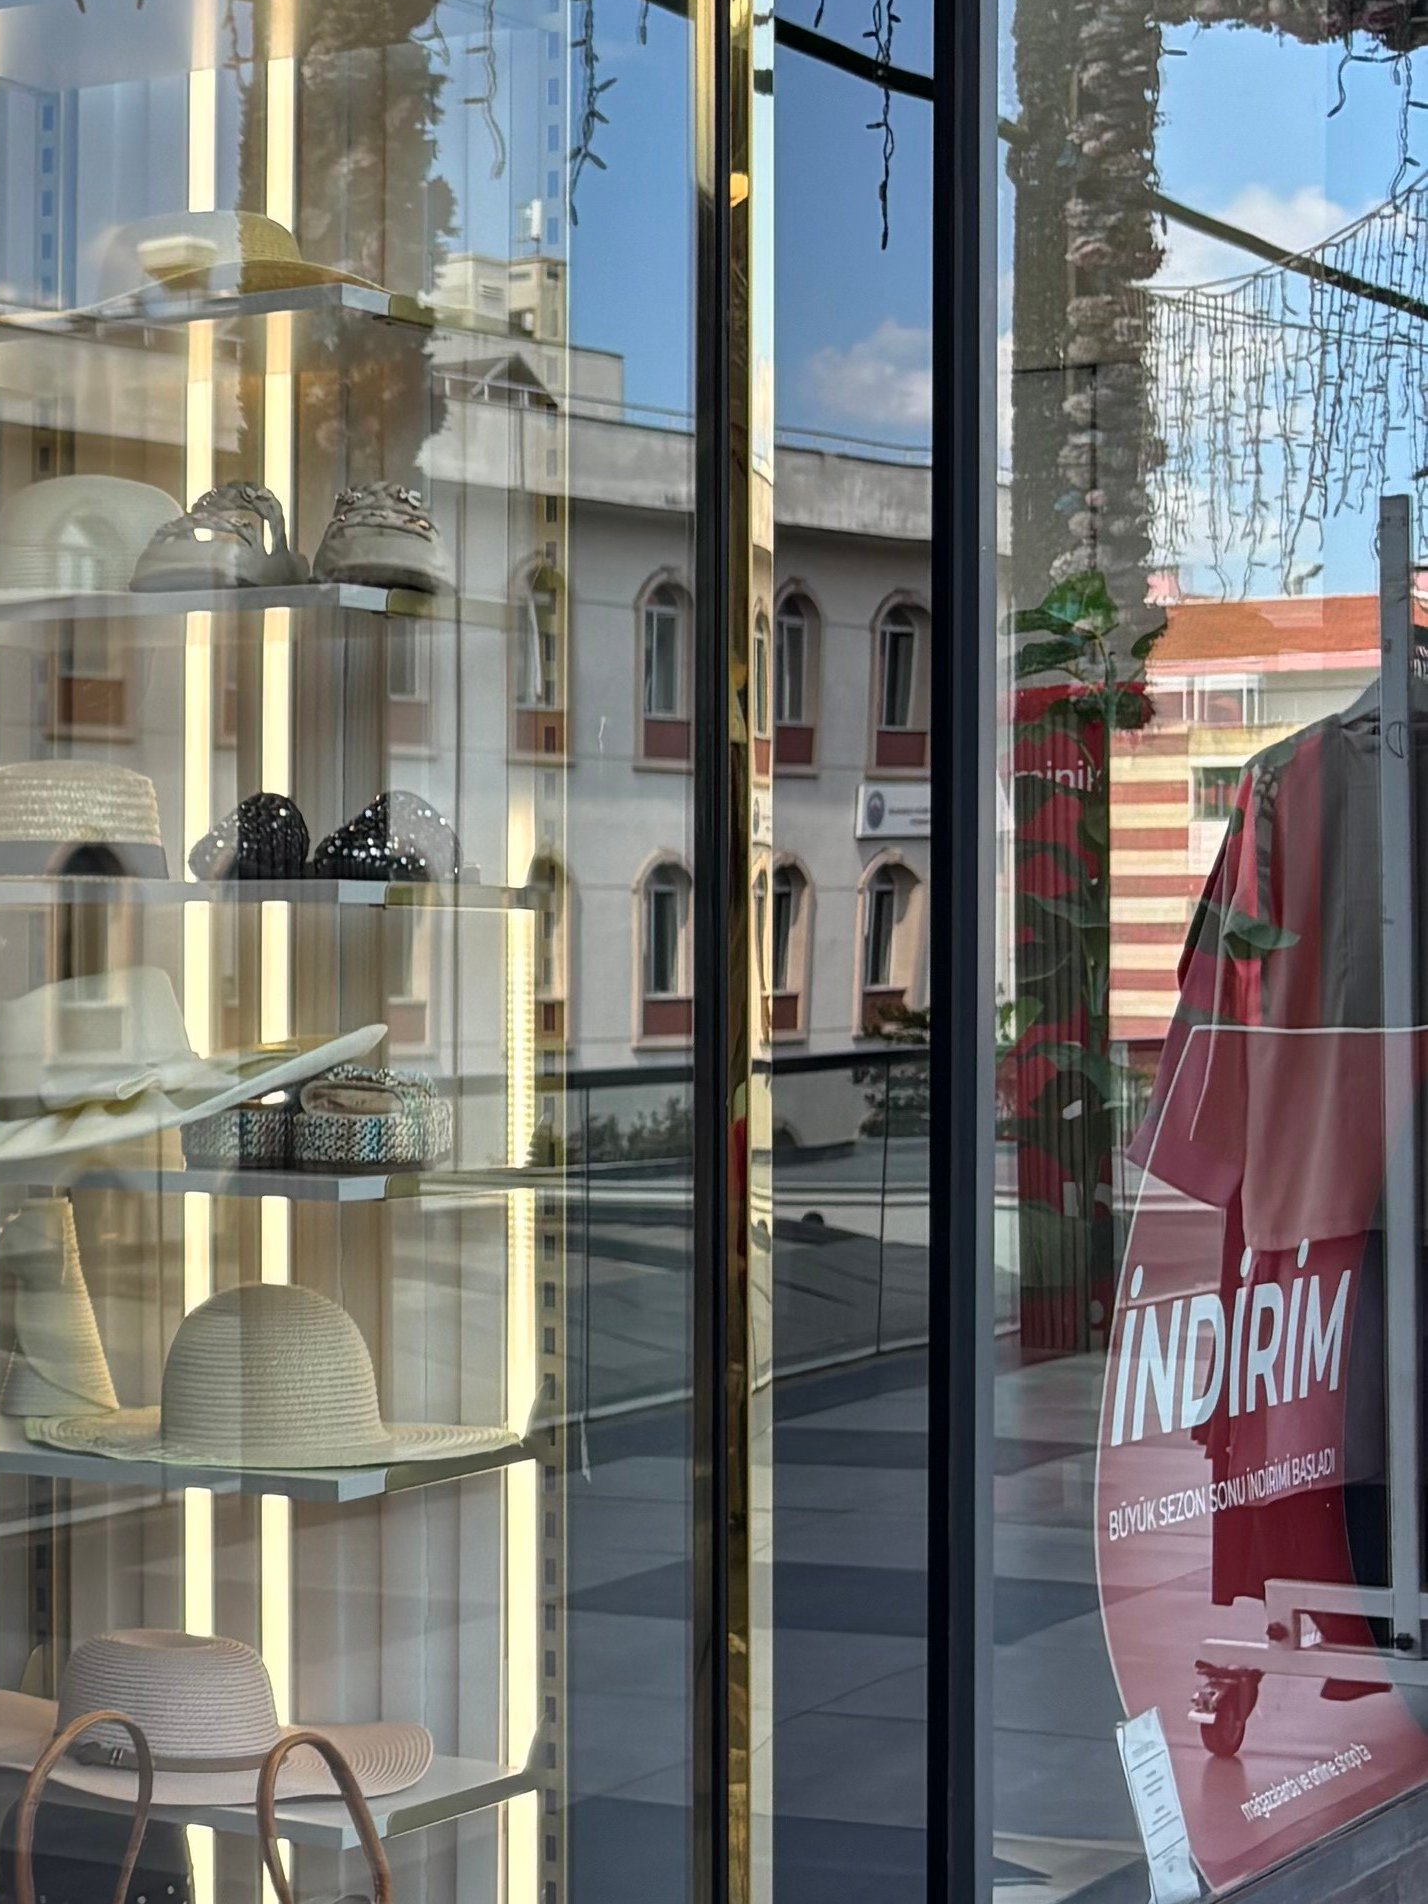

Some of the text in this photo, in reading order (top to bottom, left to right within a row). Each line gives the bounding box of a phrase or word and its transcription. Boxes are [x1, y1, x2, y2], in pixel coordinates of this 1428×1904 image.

[1110, 1238, 1351, 1447] İNDİRİM
[1108, 1447, 1336, 1542] BÜYÜK SEZON SONU İNDİRİMİ BAŞLADI
